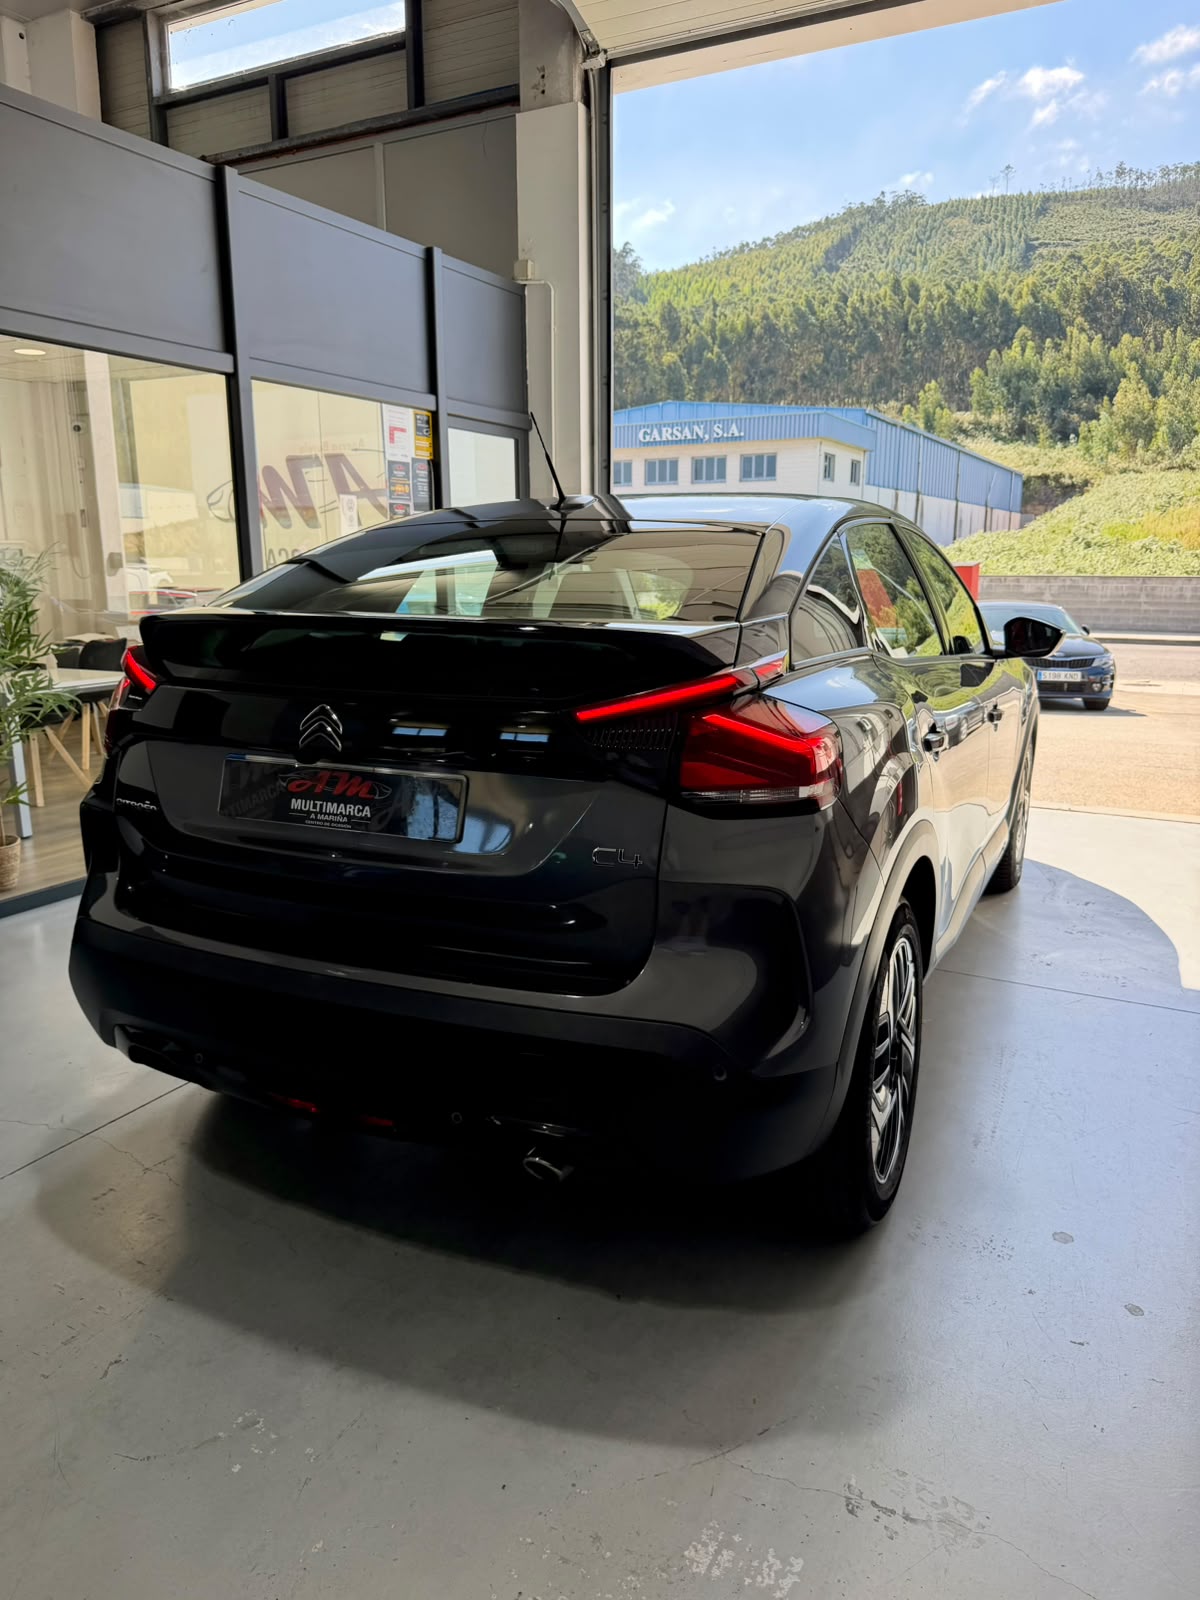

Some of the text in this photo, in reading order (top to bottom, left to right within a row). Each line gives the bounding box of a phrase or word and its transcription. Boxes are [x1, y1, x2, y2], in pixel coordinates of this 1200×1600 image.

[639, 423, 744, 442] GARSAN, S.A.
[288, 771, 377, 799] AM
[291, 798, 371, 818] MULTIMARCA
[317, 813, 348, 823] MARIÑA
[592, 847, 643, 869] C4
